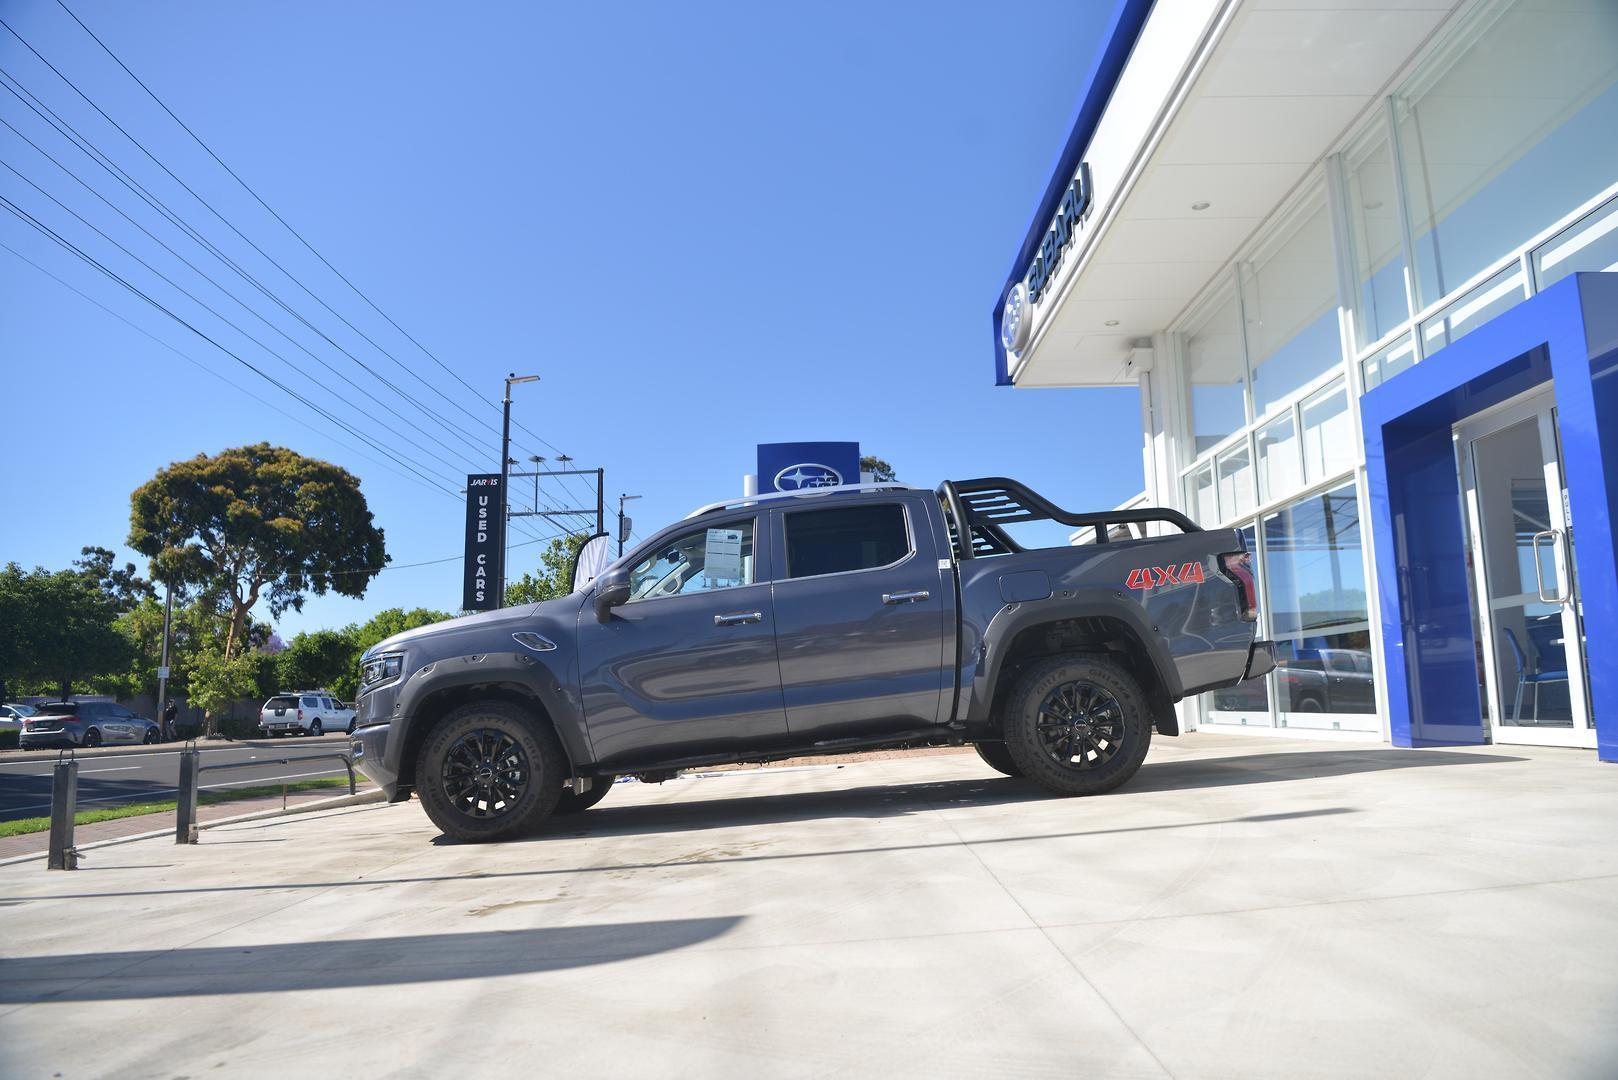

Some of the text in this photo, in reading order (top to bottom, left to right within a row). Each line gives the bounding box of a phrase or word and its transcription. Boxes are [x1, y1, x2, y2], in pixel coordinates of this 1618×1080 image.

[1028, 161, 1093, 305] SUBARU
[470, 478, 499, 486] JARVIS
[475, 495, 489, 602] USED CARS
[1125, 561, 1205, 590] 4X4
